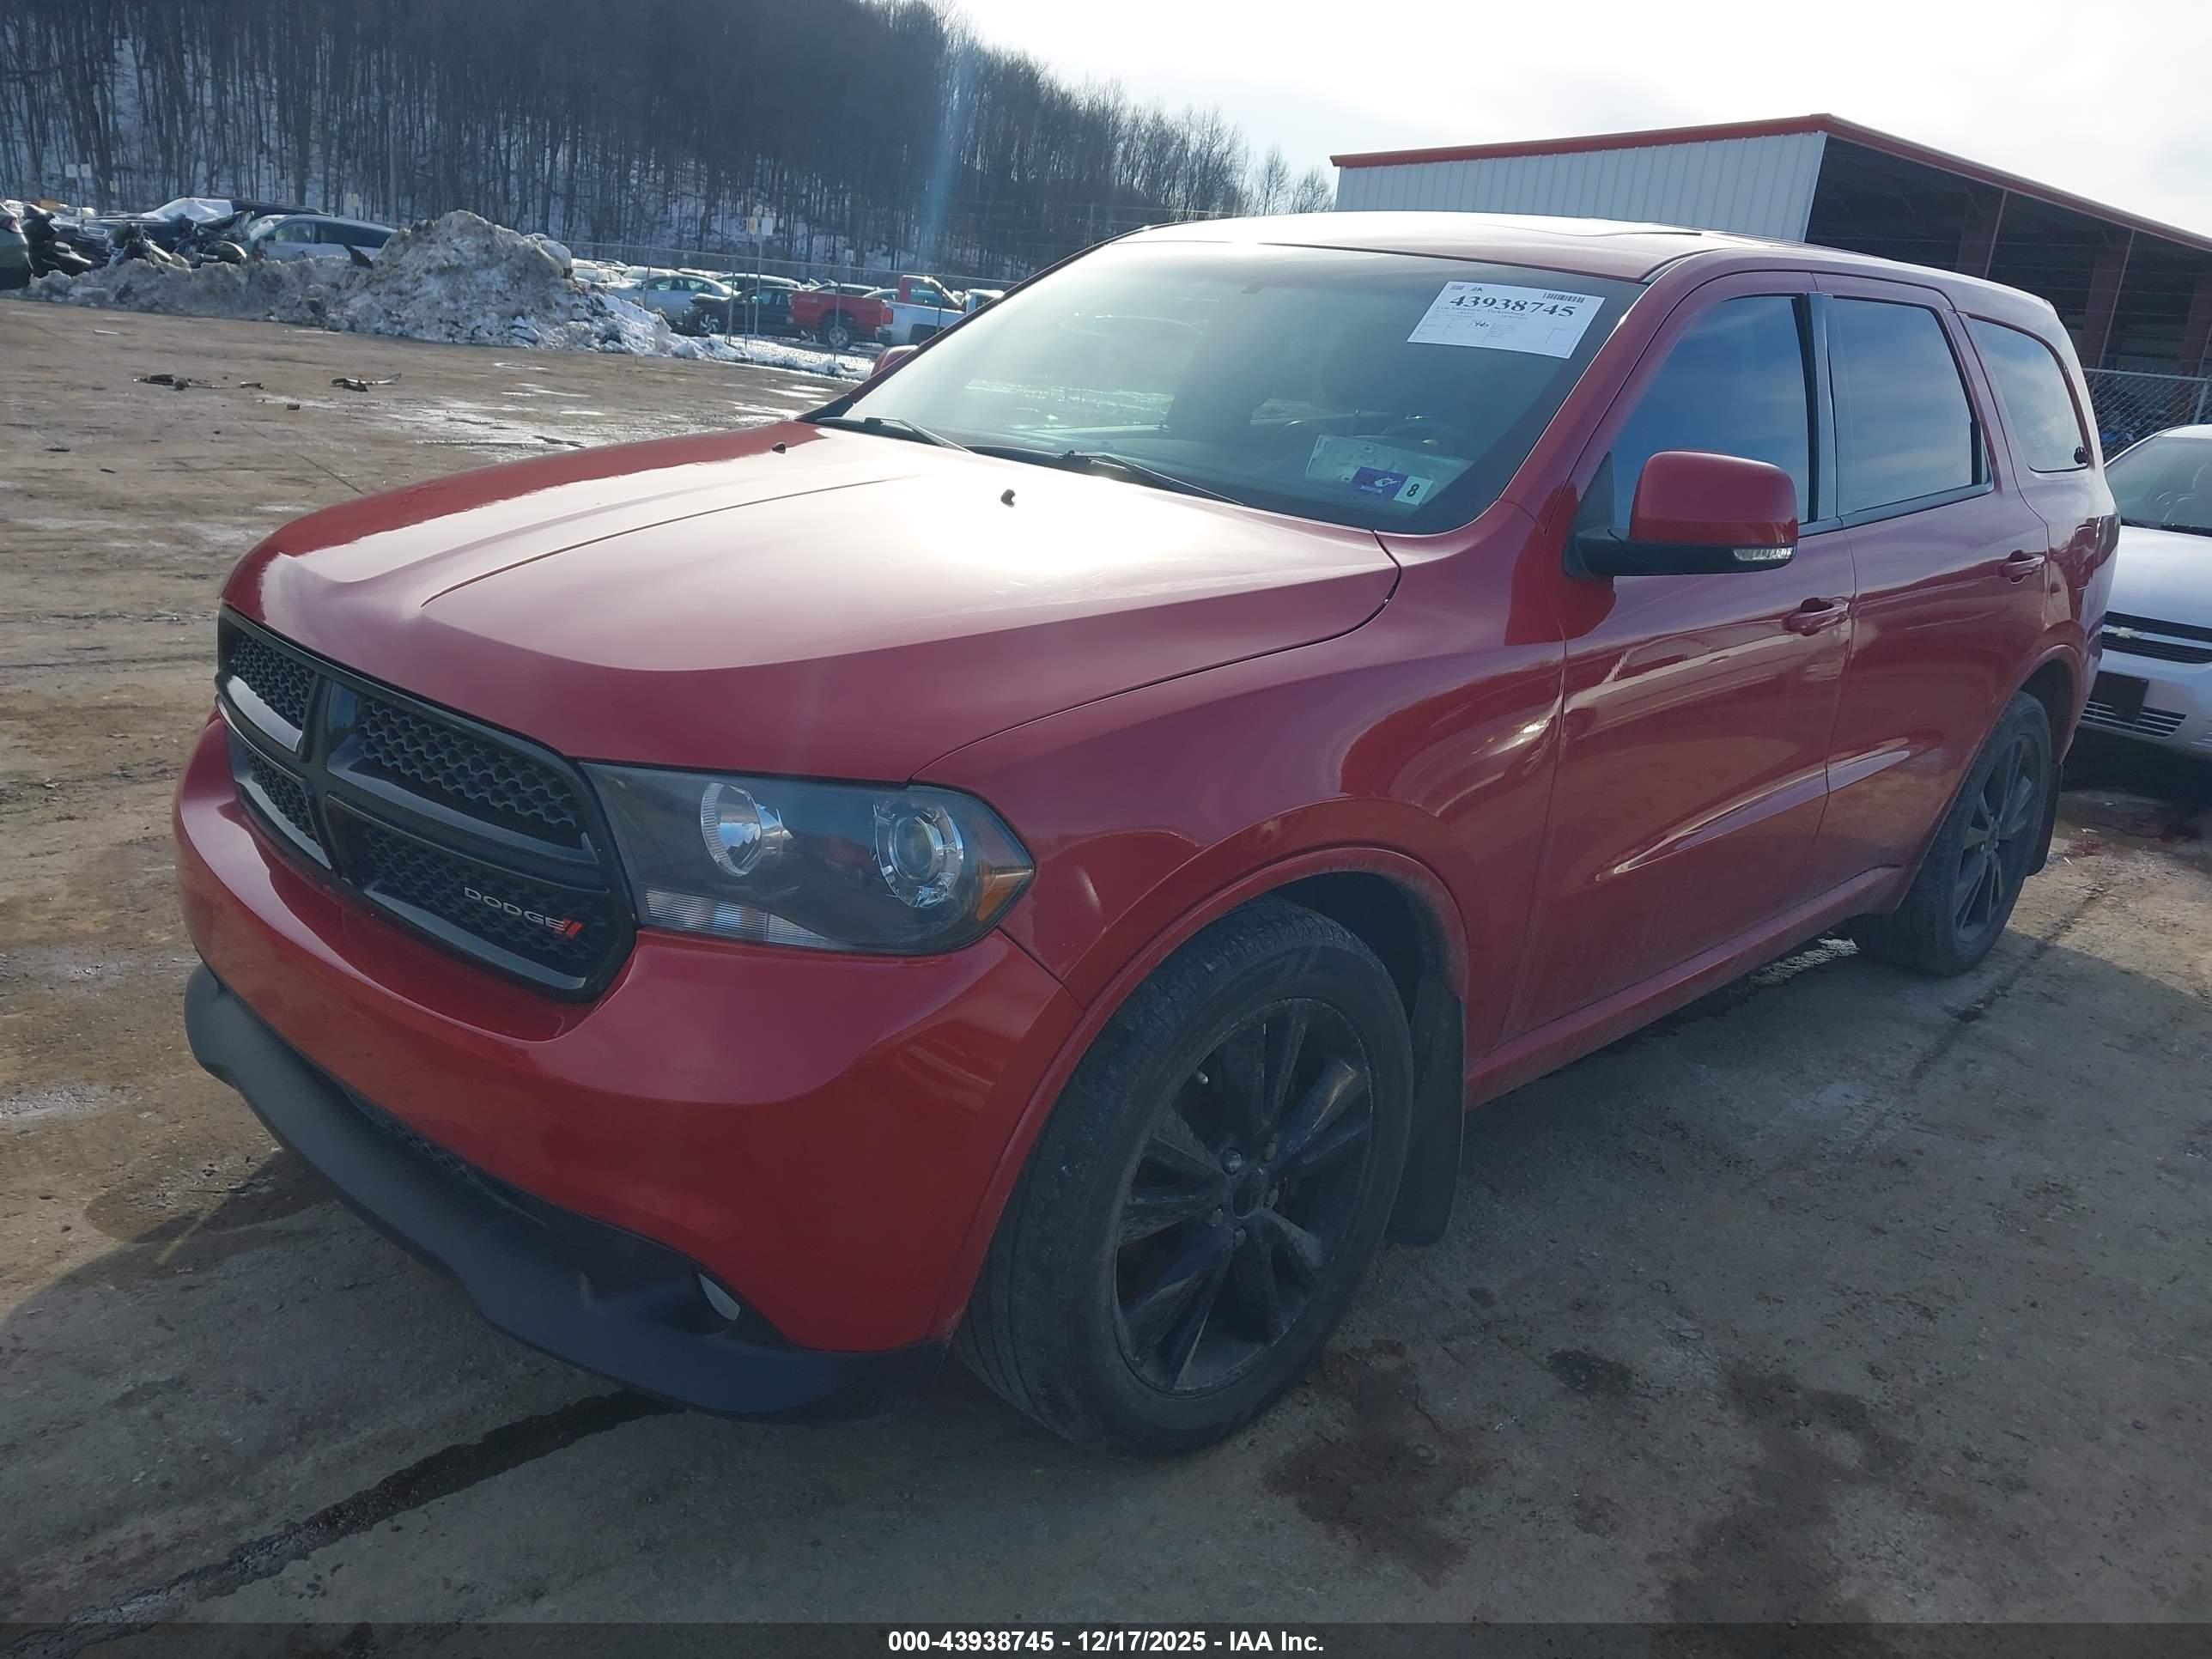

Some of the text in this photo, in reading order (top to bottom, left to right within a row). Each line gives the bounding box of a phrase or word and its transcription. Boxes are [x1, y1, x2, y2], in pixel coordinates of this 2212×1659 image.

[1449, 295, 1578, 317] 43938745
[1407, 483, 1420, 498] 8
[464, 886, 566, 932] DODGE
